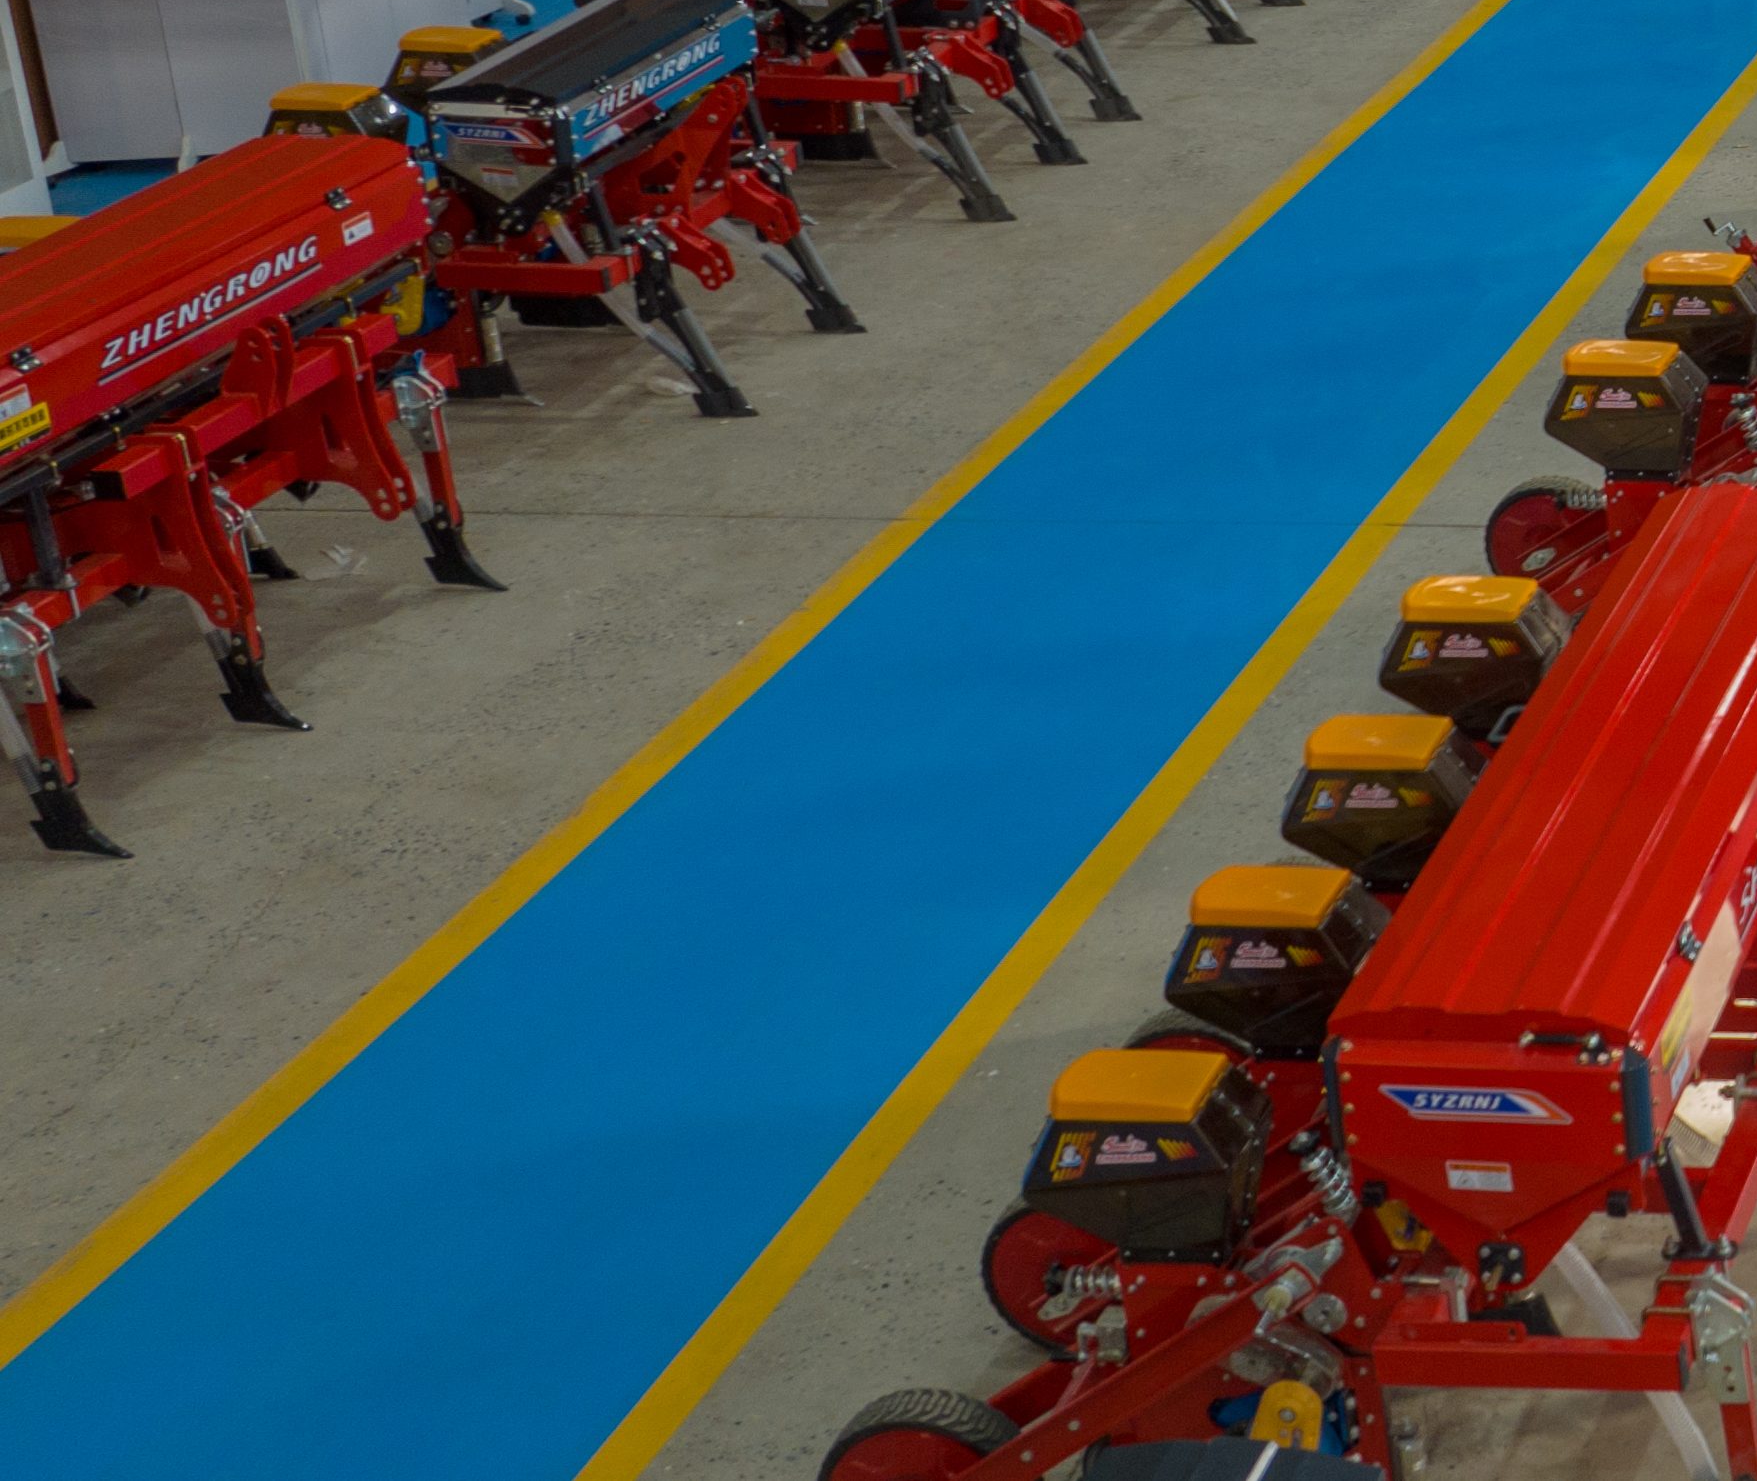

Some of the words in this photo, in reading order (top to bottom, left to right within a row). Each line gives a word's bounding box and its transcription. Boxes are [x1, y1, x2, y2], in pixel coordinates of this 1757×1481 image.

[581, 32, 721, 127] ZHENGRONG
[100, 235, 318, 369] ZHENGRONG
[1413, 1093, 1501, 1111] SYZRNJ
